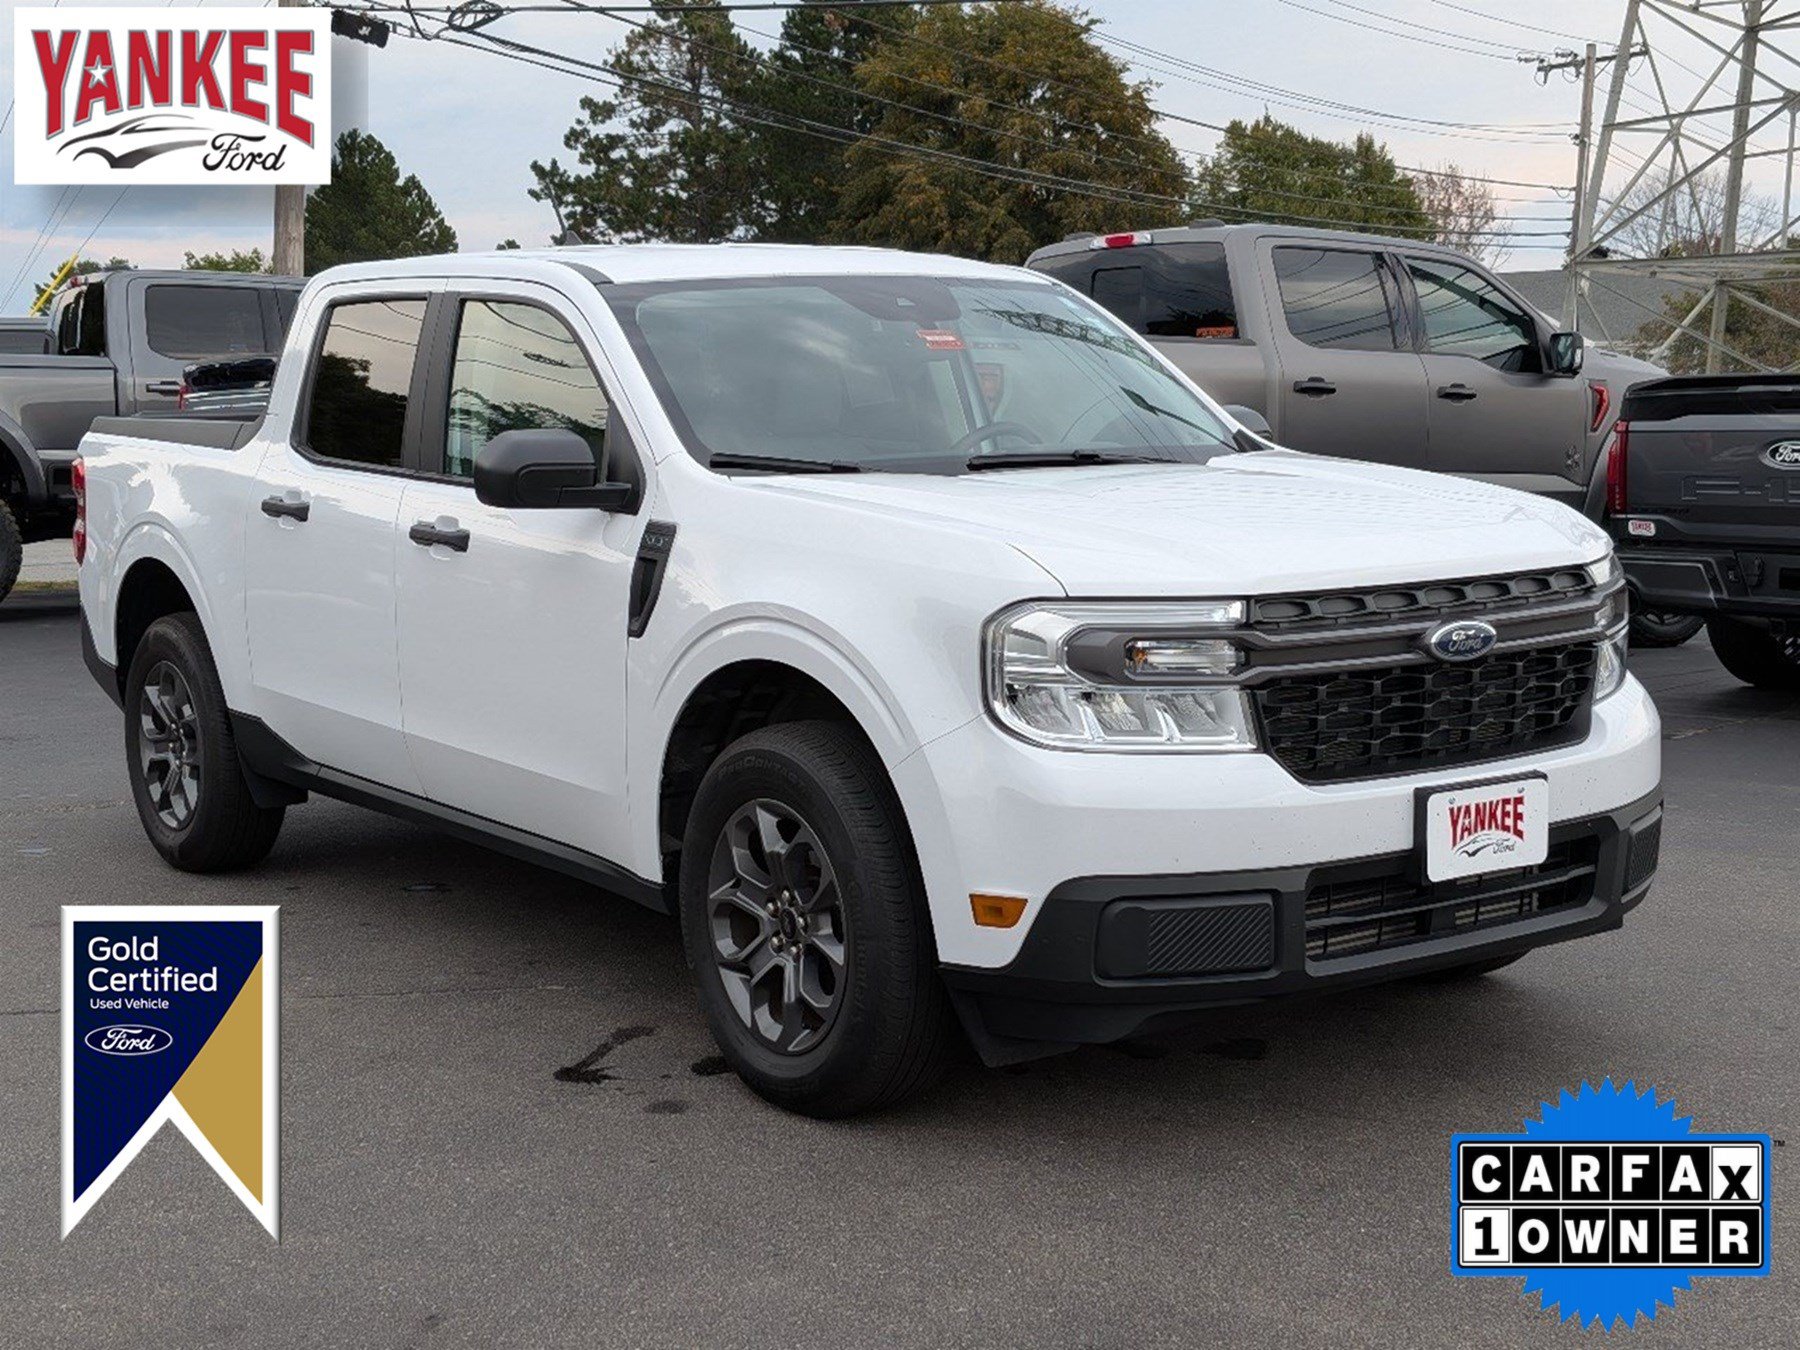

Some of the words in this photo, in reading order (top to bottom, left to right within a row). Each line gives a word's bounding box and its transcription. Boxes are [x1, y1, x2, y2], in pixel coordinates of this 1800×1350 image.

[1775, 444, 1800, 462] For
[1449, 629, 1484, 652] Ford
[1449, 795, 1525, 851] YANKEE
[1493, 837, 1517, 855] Ford
